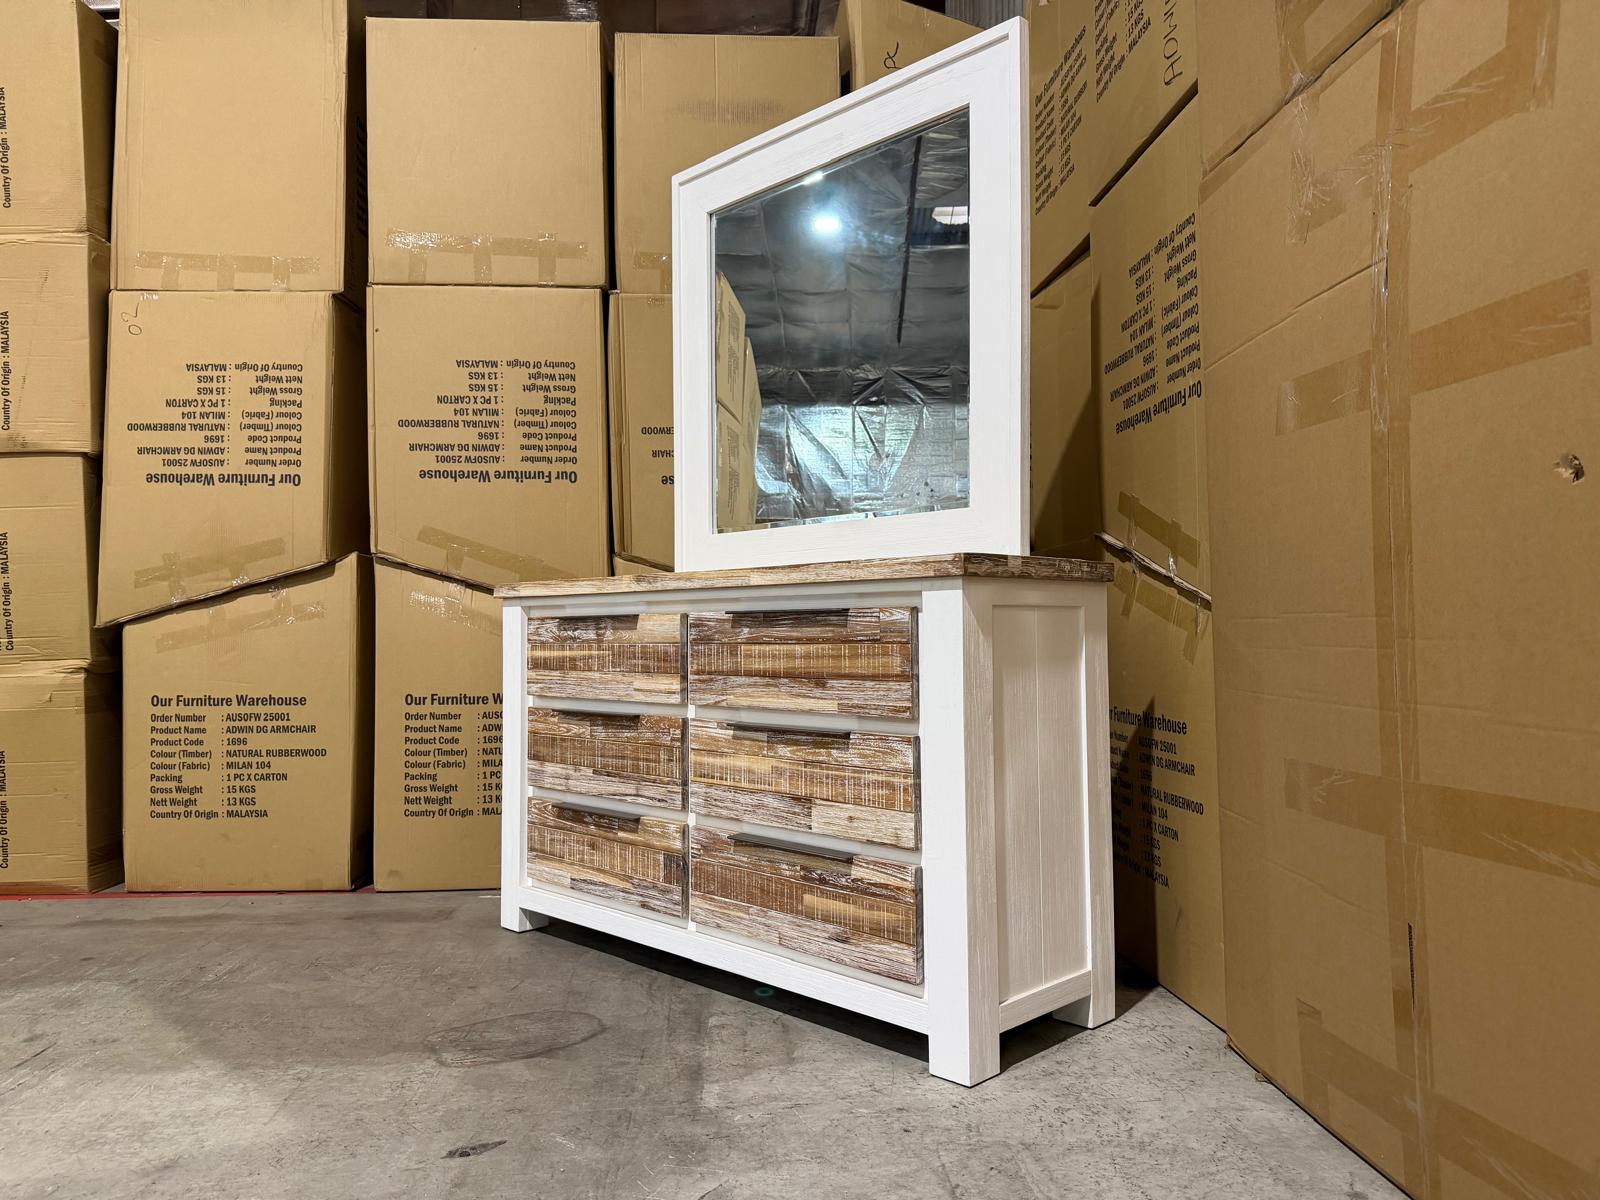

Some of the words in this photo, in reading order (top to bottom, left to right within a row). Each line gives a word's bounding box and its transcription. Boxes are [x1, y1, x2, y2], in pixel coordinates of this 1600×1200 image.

[1128, 17, 1152, 54] MALAYSIA
[0, 138, 11, 164] Origin
[1, 165, 10, 175] Of
[3, 176, 12, 209] Country
[0, 311, 10, 354] MALAYSIA
[1, 361, 12, 383] Origin
[185, 363, 227, 372] MALAYSIA
[234, 362, 259, 372] Origin
[260, 363, 270, 372] Of
[271, 362, 303, 372] Country
[197, 375, 214, 384] KGS
[216, 375, 226, 383] 13
[255, 373, 284, 384] Weight
[285, 375, 303, 384] Nett
[1, 387, 10, 397] Of
[196, 387, 213, 395] KGS
[215, 387, 225, 395] 15
[249, 385, 278, 396] Weight
[279, 387, 303, 396] Gross
[1187, 380, 1202, 399] Our
[165, 398, 199, 408] CARTON
[200, 399, 206, 408] X
[207, 398, 218, 408] PC
[220, 398, 226, 407] 1
[269, 398, 302, 408] Packing
[1153, 388, 1186, 416] Furniture
[1, 399, 12, 431] Country
[181, 411, 196, 419] 104
[199, 411, 226, 420] MILAN
[241, 410, 274, 420] (Fabric)
[275, 411, 302, 420] Colour
[397, 419, 459, 428] RUBBERWOOD
[461, 419, 499, 428] NATURAL
[513, 419, 548, 429] (Timber)
[550, 421, 577, 430] Colour
[1115, 407, 1152, 434] Warehouse
[127, 422, 186, 431] RUBBERWOOD
[188, 423, 225, 431] NATURAL
[239, 422, 273, 432] (Timber)
[275, 423, 302, 432] Colour
[204, 435, 224, 443] 1696
[247, 435, 268, 444] Code
[269, 435, 302, 444] Product
[137, 446, 182, 455] ARMCHAIR
[183, 446, 195, 455] DG
[197, 446, 225, 455] ADWIN
[244, 446, 268, 455] Name
[269, 447, 302, 456] Product
[408, 443, 455, 452] ARMCHAIR
[457, 443, 469, 452] DG
[471, 443, 500, 452] ADWIN
[519, 444, 543, 452] Name
[545, 444, 577, 453] Product
[161, 458, 188, 467] 25001
[189, 458, 225, 467] AUSOFW
[245, 458, 277, 467] Number
[278, 459, 302, 468] Order
[435, 455, 462, 464] 25001
[464, 455, 500, 464] AUSOFW
[520, 455, 553, 464] Number
[554, 456, 578, 465] Order
[146, 473, 215, 486] Warehouse
[218, 473, 275, 486] Furniture
[278, 473, 301, 487] Our
[419, 469, 491, 483] Warehouse
[493, 470, 552, 483] Furniture
[554, 471, 577, 483] Our
[0, 532, 9, 575] MALAYSIA
[2, 582, 13, 607] Origin
[3, 608, 12, 618] Of
[5, 619, 15, 651] Country
[151, 695, 173, 707] Our
[176, 694, 232, 707] Furniture
[235, 694, 307, 706] Warehouse
[404, 693, 427, 706] Our
[430, 693, 489, 705] Furniture
[150, 713, 173, 722] Order
[174, 713, 206, 722] Number
[225, 712, 262, 722] AUSOFW
[263, 712, 290, 722] 25001
[1114, 705, 1142, 727] Furniture
[1143, 711, 1187, 735] Warehouse
[150, 726, 182, 734] Product
[183, 726, 207, 734] Name
[225, 725, 254, 734] ADWIN
[256, 725, 268, 734] DG
[269, 724, 316, 733] ARMCHAIR
[150, 737, 182, 746] Product
[183, 737, 204, 746] Code
[226, 737, 248, 746] 1696
[1159, 739, 1178, 755] 25001
[150, 749, 176, 758] Colour
[178, 749, 212, 759] (Timber)
[226, 749, 264, 758] NATURAL
[265, 748, 327, 757] RUBBERWOOD
[404, 748, 431, 757] Colour
[433, 747, 468, 758] (Timber)
[150, 761, 176, 770] Colour
[178, 761, 210, 771] (Fabric)
[226, 761, 252, 770] MILAN
[256, 761, 271, 769] 104
[1164, 758, 1196, 777] ARMCHAIR
[150, 773, 183, 783] Packing
[226, 773, 231, 782] 1
[233, 773, 245, 781] PC
[246, 773, 252, 781] X
[253, 772, 288, 781] CARTON
[150, 785, 173, 794] Gross
[174, 785, 203, 796] Weight
[227, 785, 237, 794] 15
[239, 784, 256, 794] KGS
[150, 797, 167, 807] Nett
[169, 797, 197, 808] Weight
[227, 797, 237, 806] 13
[239, 796, 256, 806] KGS
[1163, 791, 1204, 816] RUBBERWOOD
[0, 801, 9, 825] Origin
[150, 810, 181, 820] Country
[183, 809, 192, 818] Of
[194, 810, 219, 820] Origin
[226, 809, 268, 818] MALAYSIA
[404, 808, 436, 819] Country
[437, 808, 447, 817] Of
[449, 807, 474, 818] Origin
[0, 826, 9, 836] Of
[1158, 826, 1179, 842] CARTON
[0, 837, 11, 870] Country
